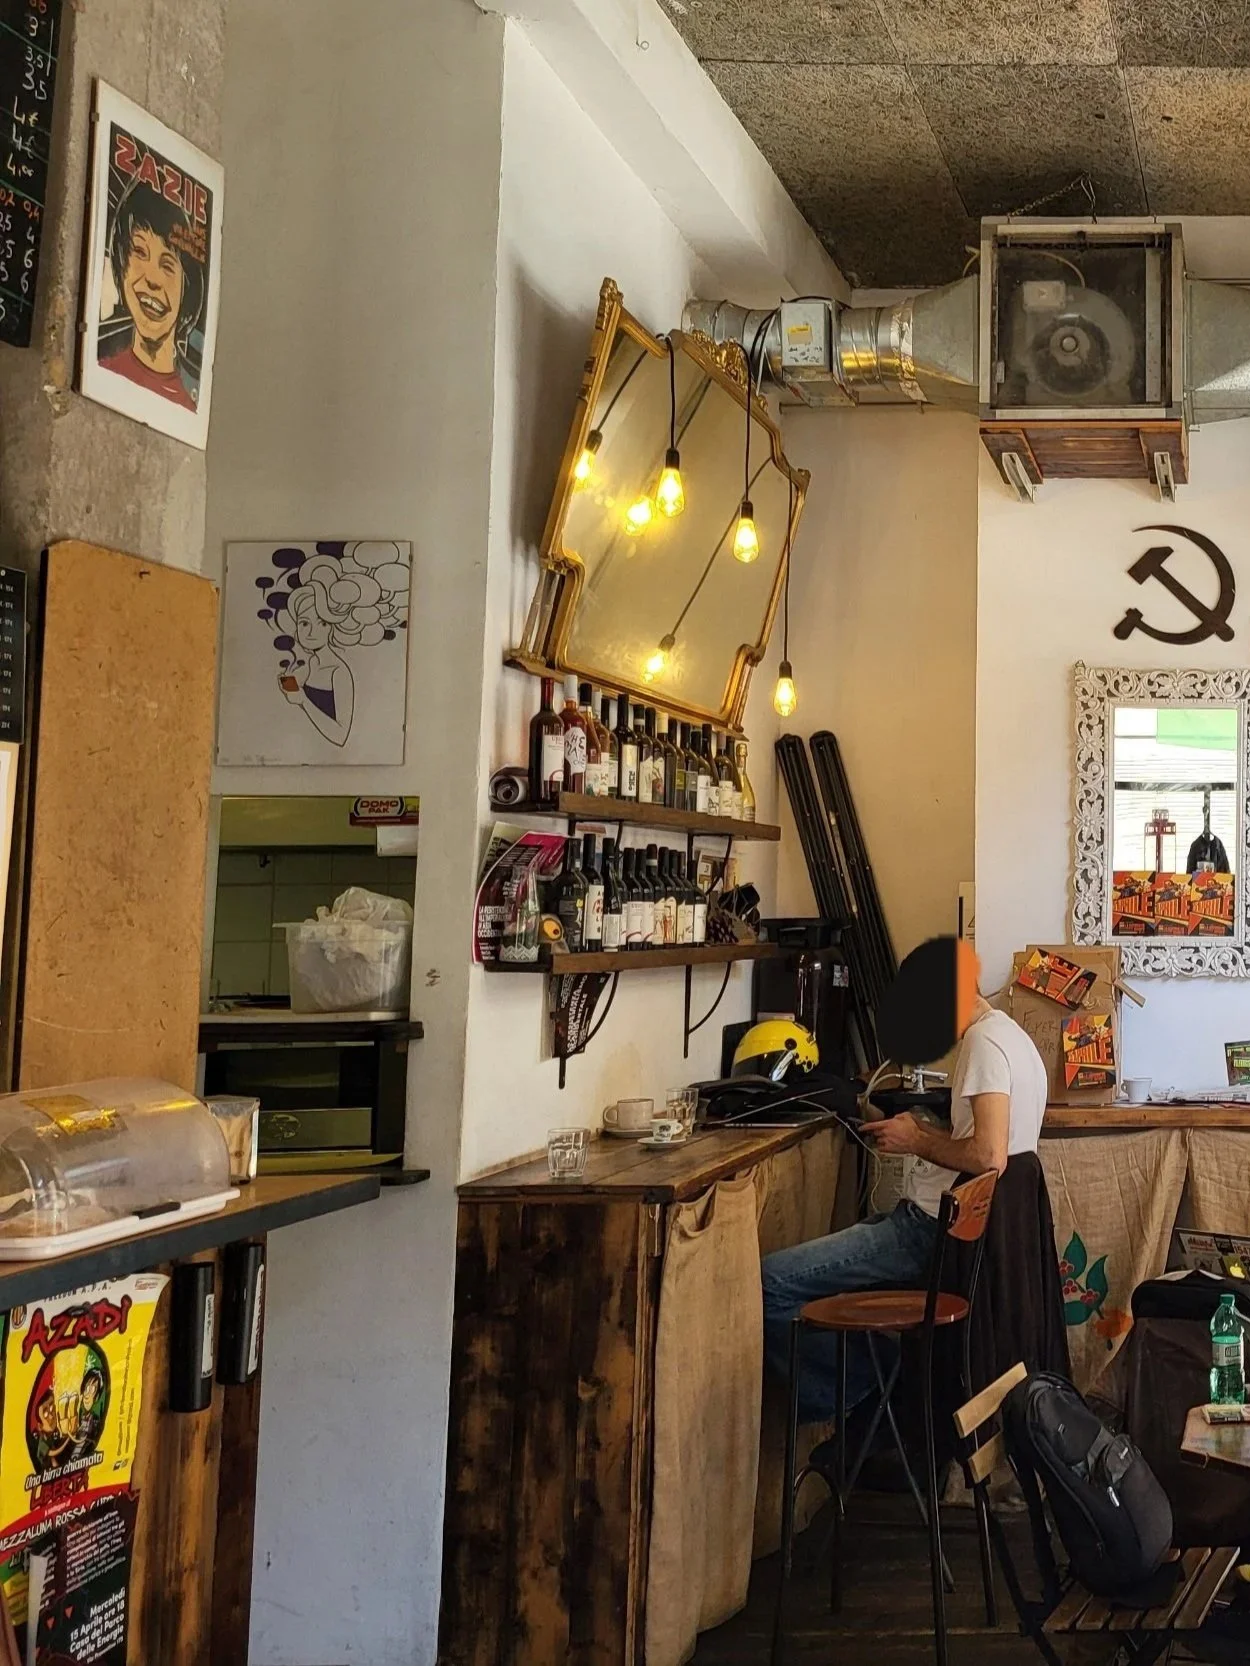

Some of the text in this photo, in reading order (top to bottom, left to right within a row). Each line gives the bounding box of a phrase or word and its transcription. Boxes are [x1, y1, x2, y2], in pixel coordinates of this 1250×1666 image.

[115, 134, 208, 225] ZAZIE
[360, 800, 399, 808] DOMO
[21, 1294, 133, 1364] AZADI
[55, 1504, 87, 1529] ROSSA
[69, 1612, 125, 1654] Casa del Parco
[70, 1599, 125, 1642] 15 Aprile ore 18
[76, 1624, 124, 1662] delle Energie
